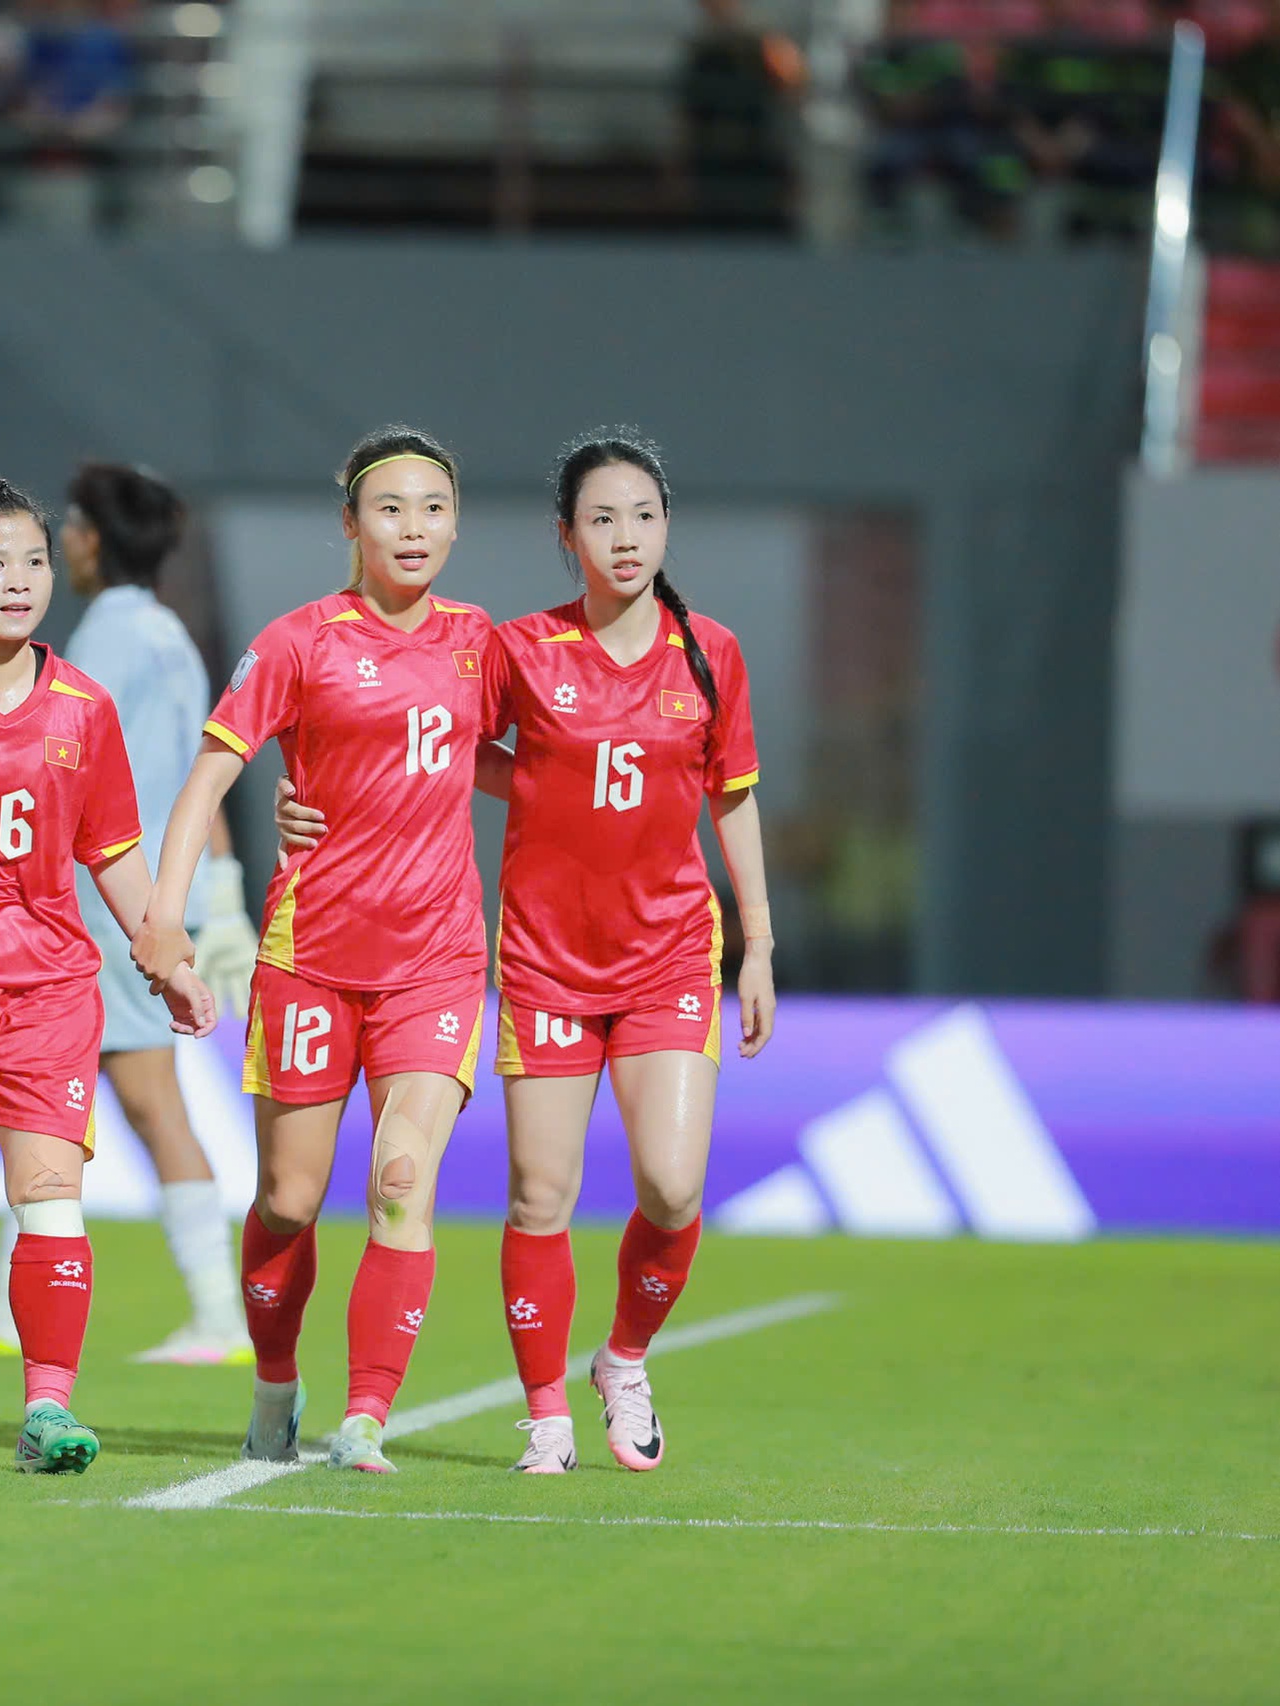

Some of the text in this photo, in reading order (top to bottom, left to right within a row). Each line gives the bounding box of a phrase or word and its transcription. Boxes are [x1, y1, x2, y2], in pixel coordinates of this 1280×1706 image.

[405, 703, 453, 777] 12
[593, 739, 646, 812] 15
[280, 1002, 332, 1076] 12
